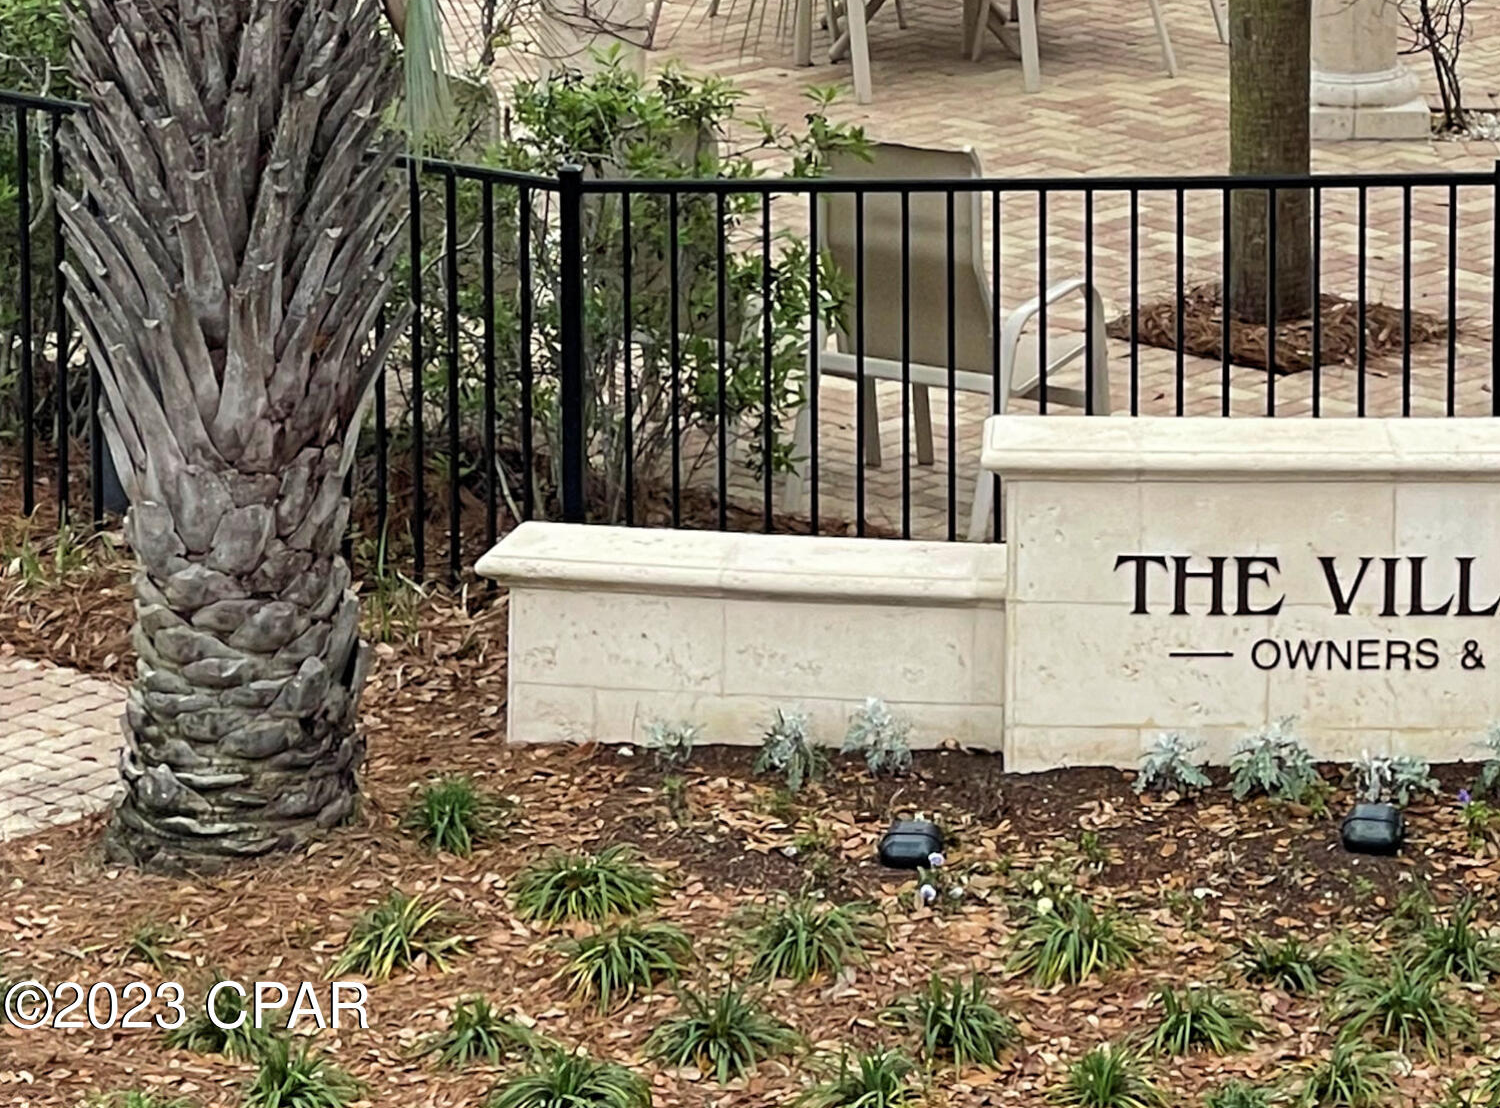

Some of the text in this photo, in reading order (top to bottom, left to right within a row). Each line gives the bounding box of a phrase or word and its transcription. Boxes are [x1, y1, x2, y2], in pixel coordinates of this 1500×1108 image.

[1114, 555, 1286, 617] THE
[1251, 638, 1440, 671] OWNERS
[1460, 639, 1486, 671] &
